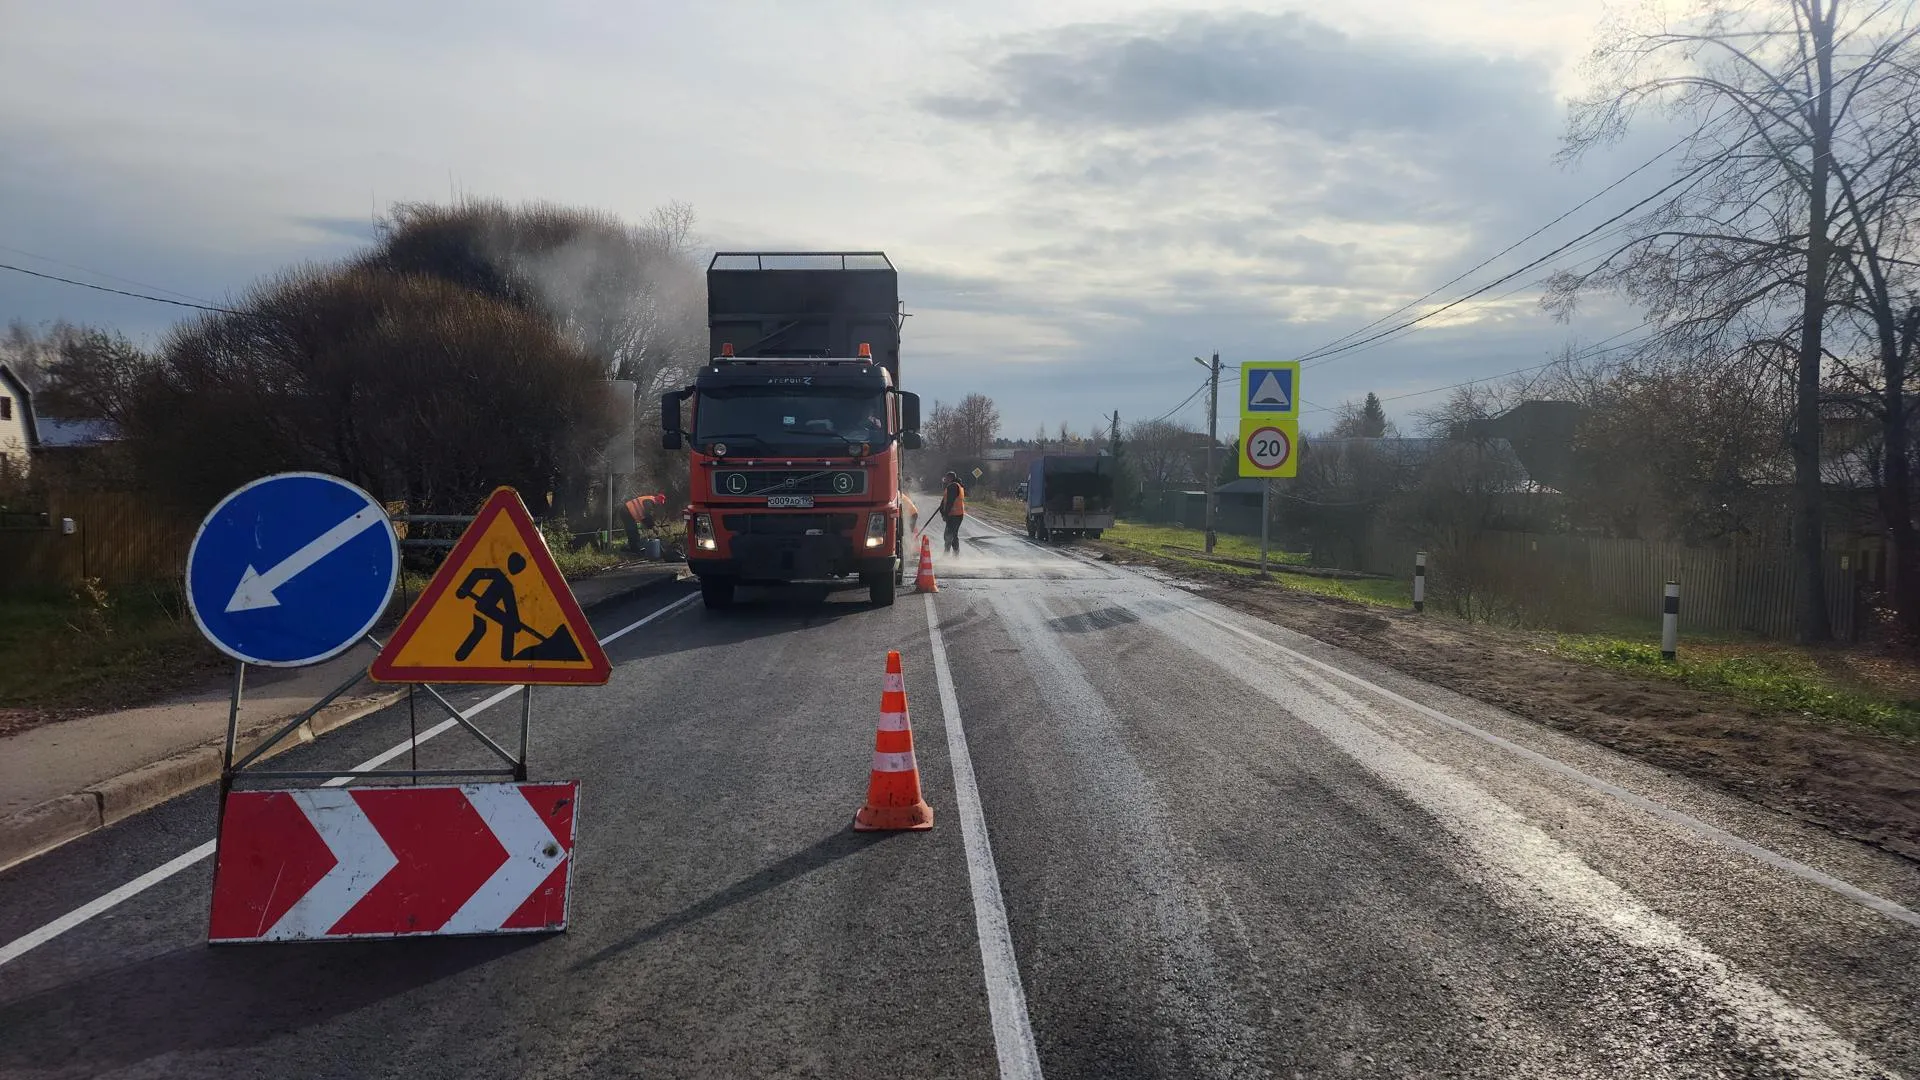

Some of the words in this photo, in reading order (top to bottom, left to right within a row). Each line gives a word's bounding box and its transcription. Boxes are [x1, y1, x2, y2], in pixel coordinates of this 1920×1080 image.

[1256, 439, 1281, 457] 20
[732, 477, 741, 490] L
[839, 477, 848, 489] 3
